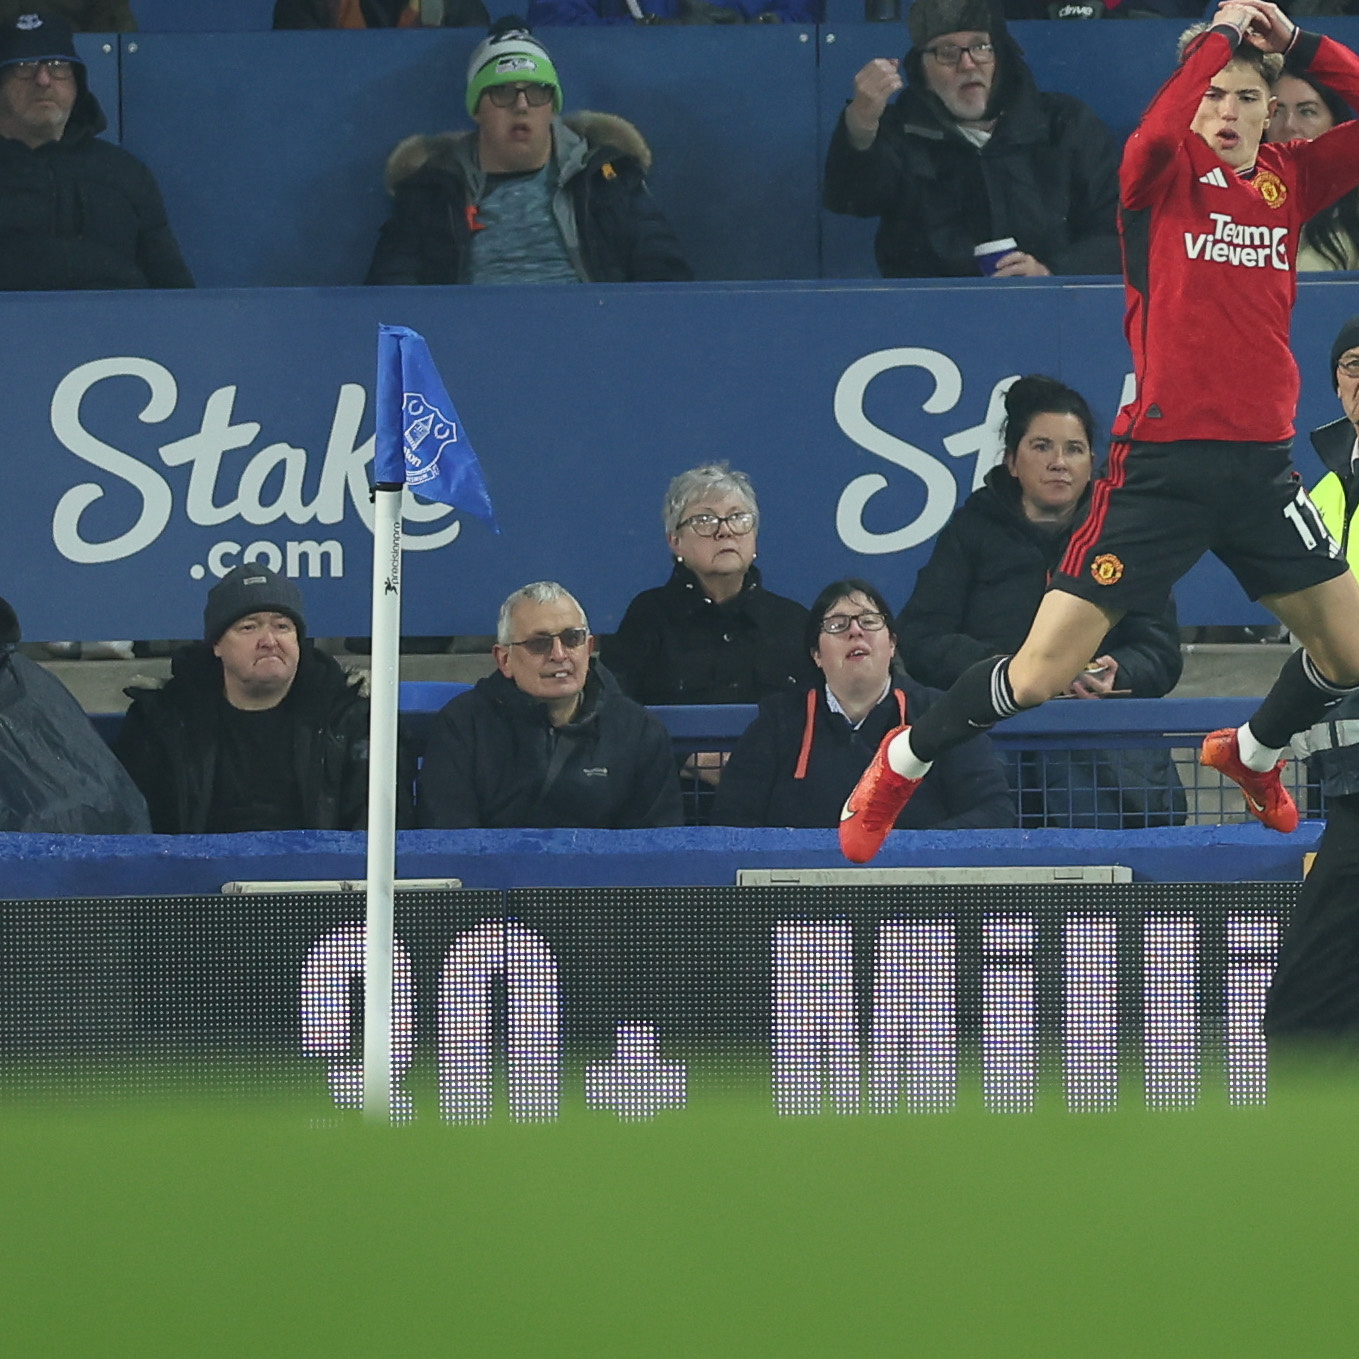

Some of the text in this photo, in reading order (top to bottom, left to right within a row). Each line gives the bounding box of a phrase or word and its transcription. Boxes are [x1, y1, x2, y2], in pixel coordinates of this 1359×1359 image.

[1208, 212, 1271, 246] Team
[189, 540, 344, 580] .com
[391, 521, 401, 586] precisionpro
